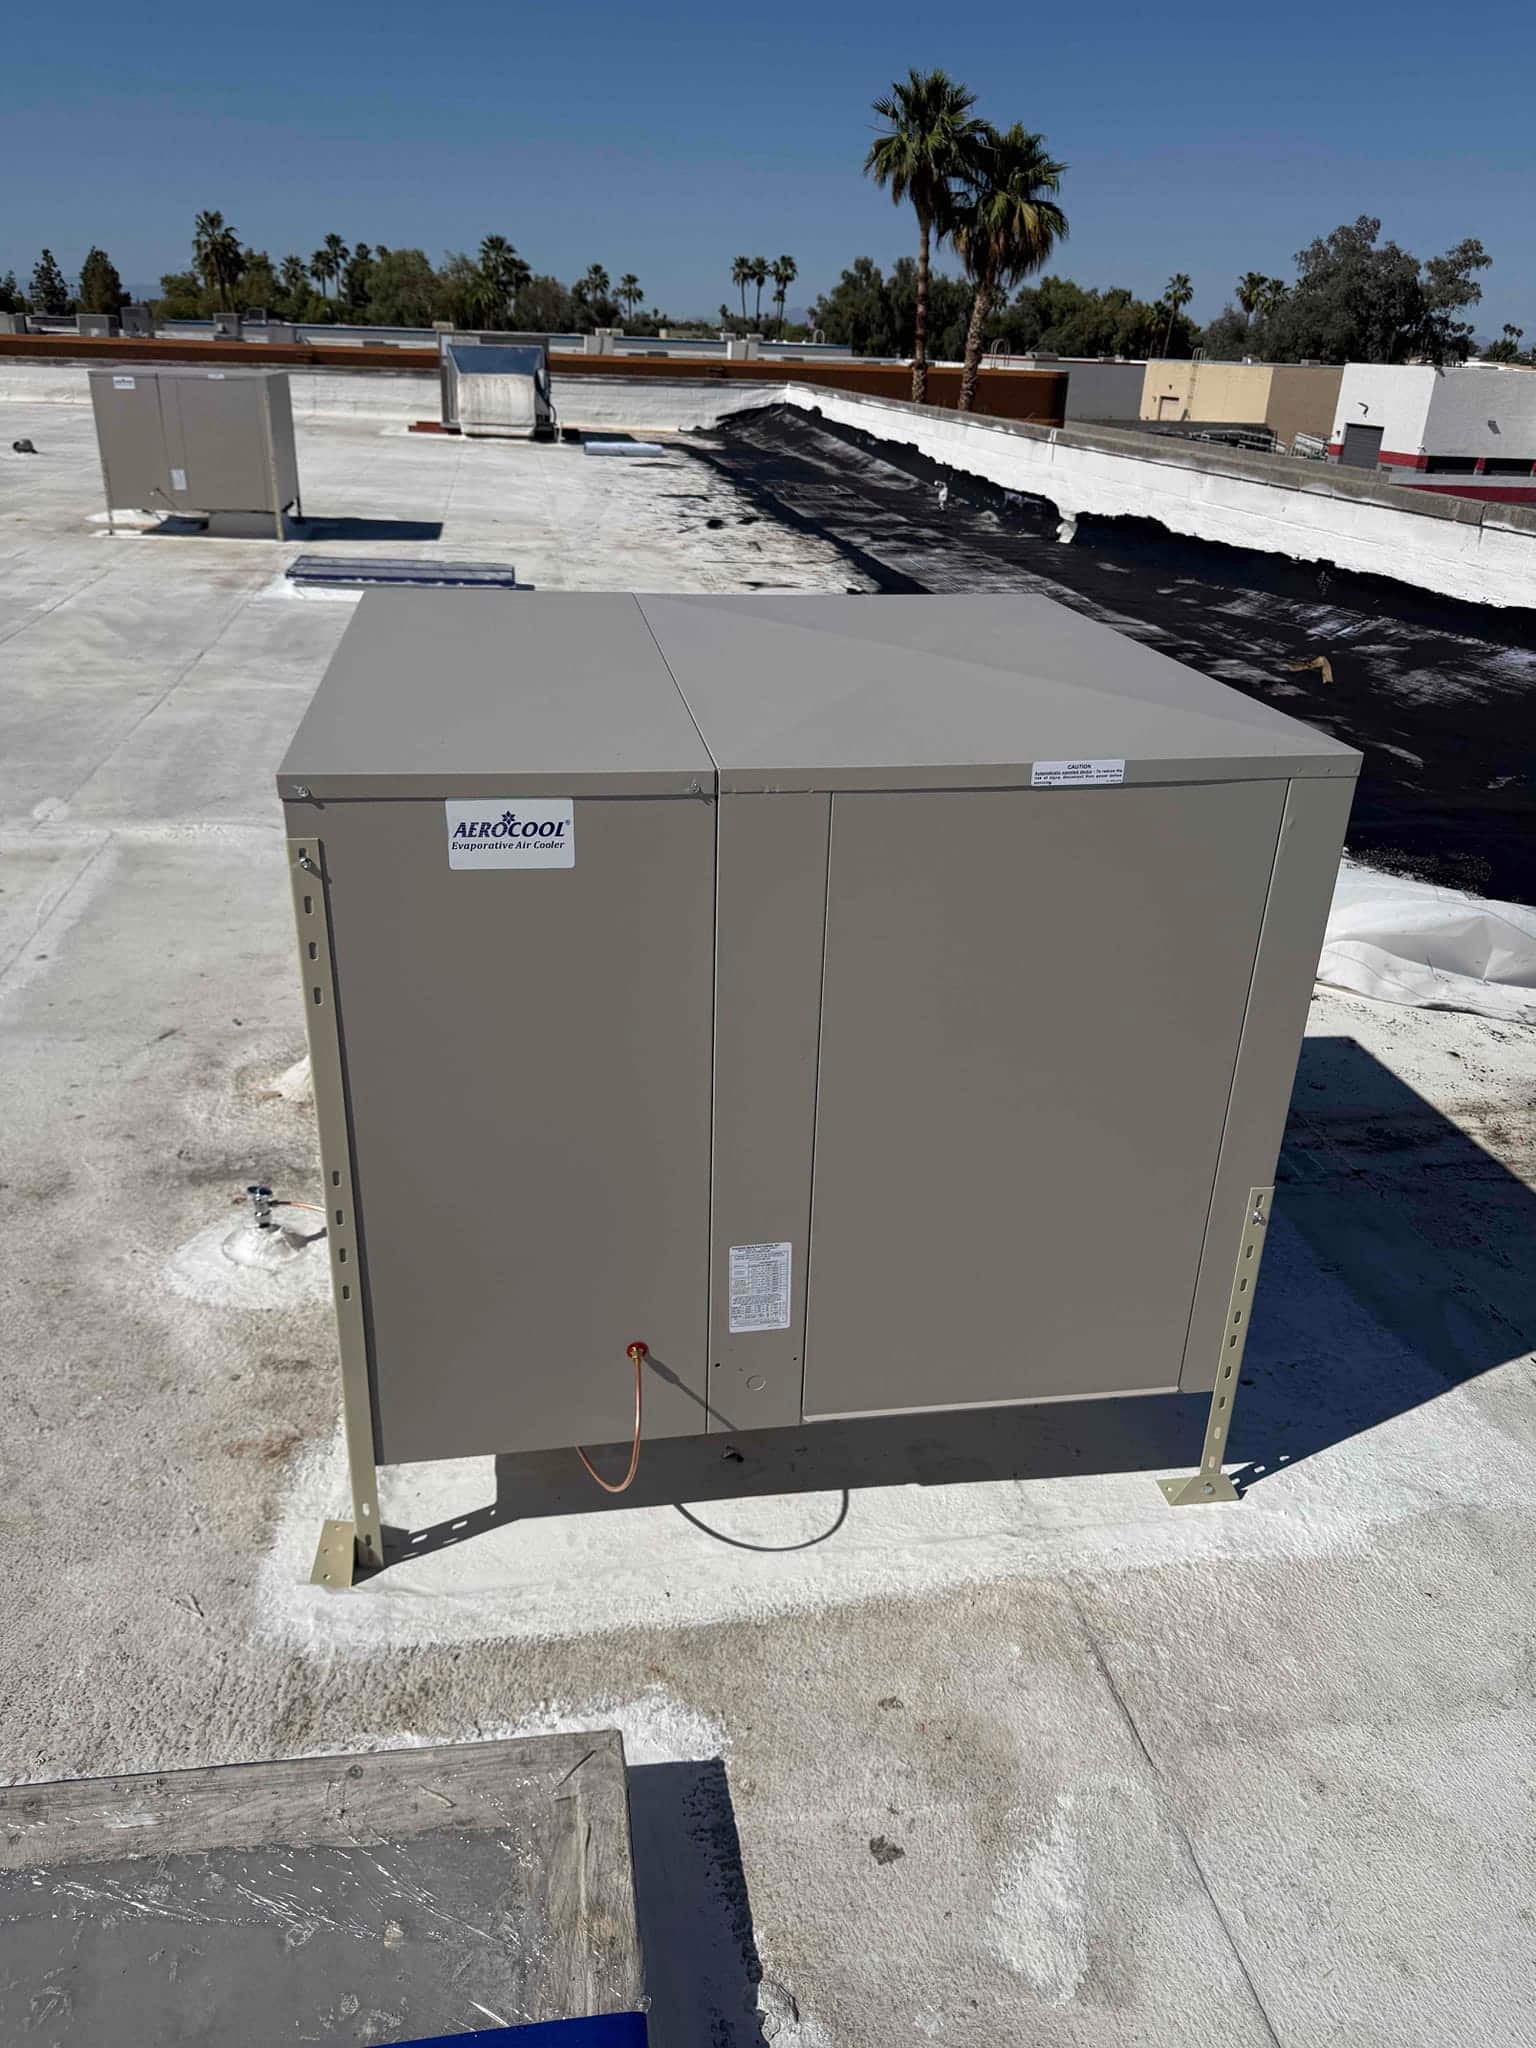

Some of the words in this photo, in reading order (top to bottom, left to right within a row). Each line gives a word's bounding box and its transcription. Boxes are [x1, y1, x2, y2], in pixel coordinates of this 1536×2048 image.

[453, 821, 565, 838] AEROCOOL
[452, 841, 514, 851] Evaporative
[515, 841, 531, 849] Air
[533, 841, 565, 849] Cooler
